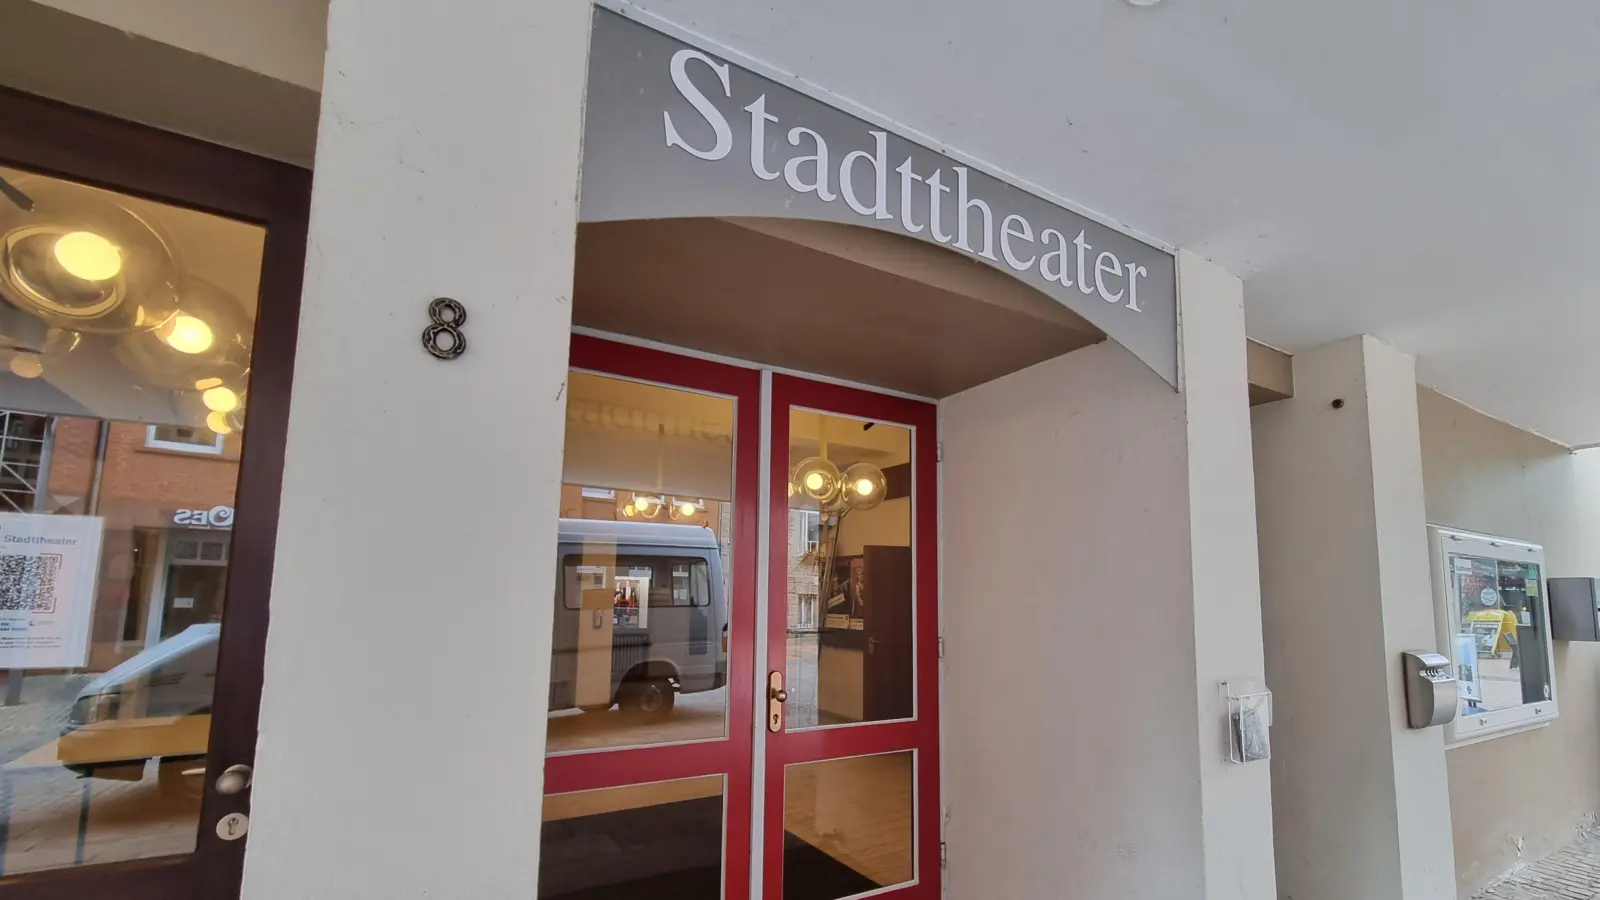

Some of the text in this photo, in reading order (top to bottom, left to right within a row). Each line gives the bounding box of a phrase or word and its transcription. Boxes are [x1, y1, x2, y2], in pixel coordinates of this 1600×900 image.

[664, 48, 1147, 313] Stadttheater
[422, 297, 467, 360] 8
[3, 534, 78, 546] Stadttheater
